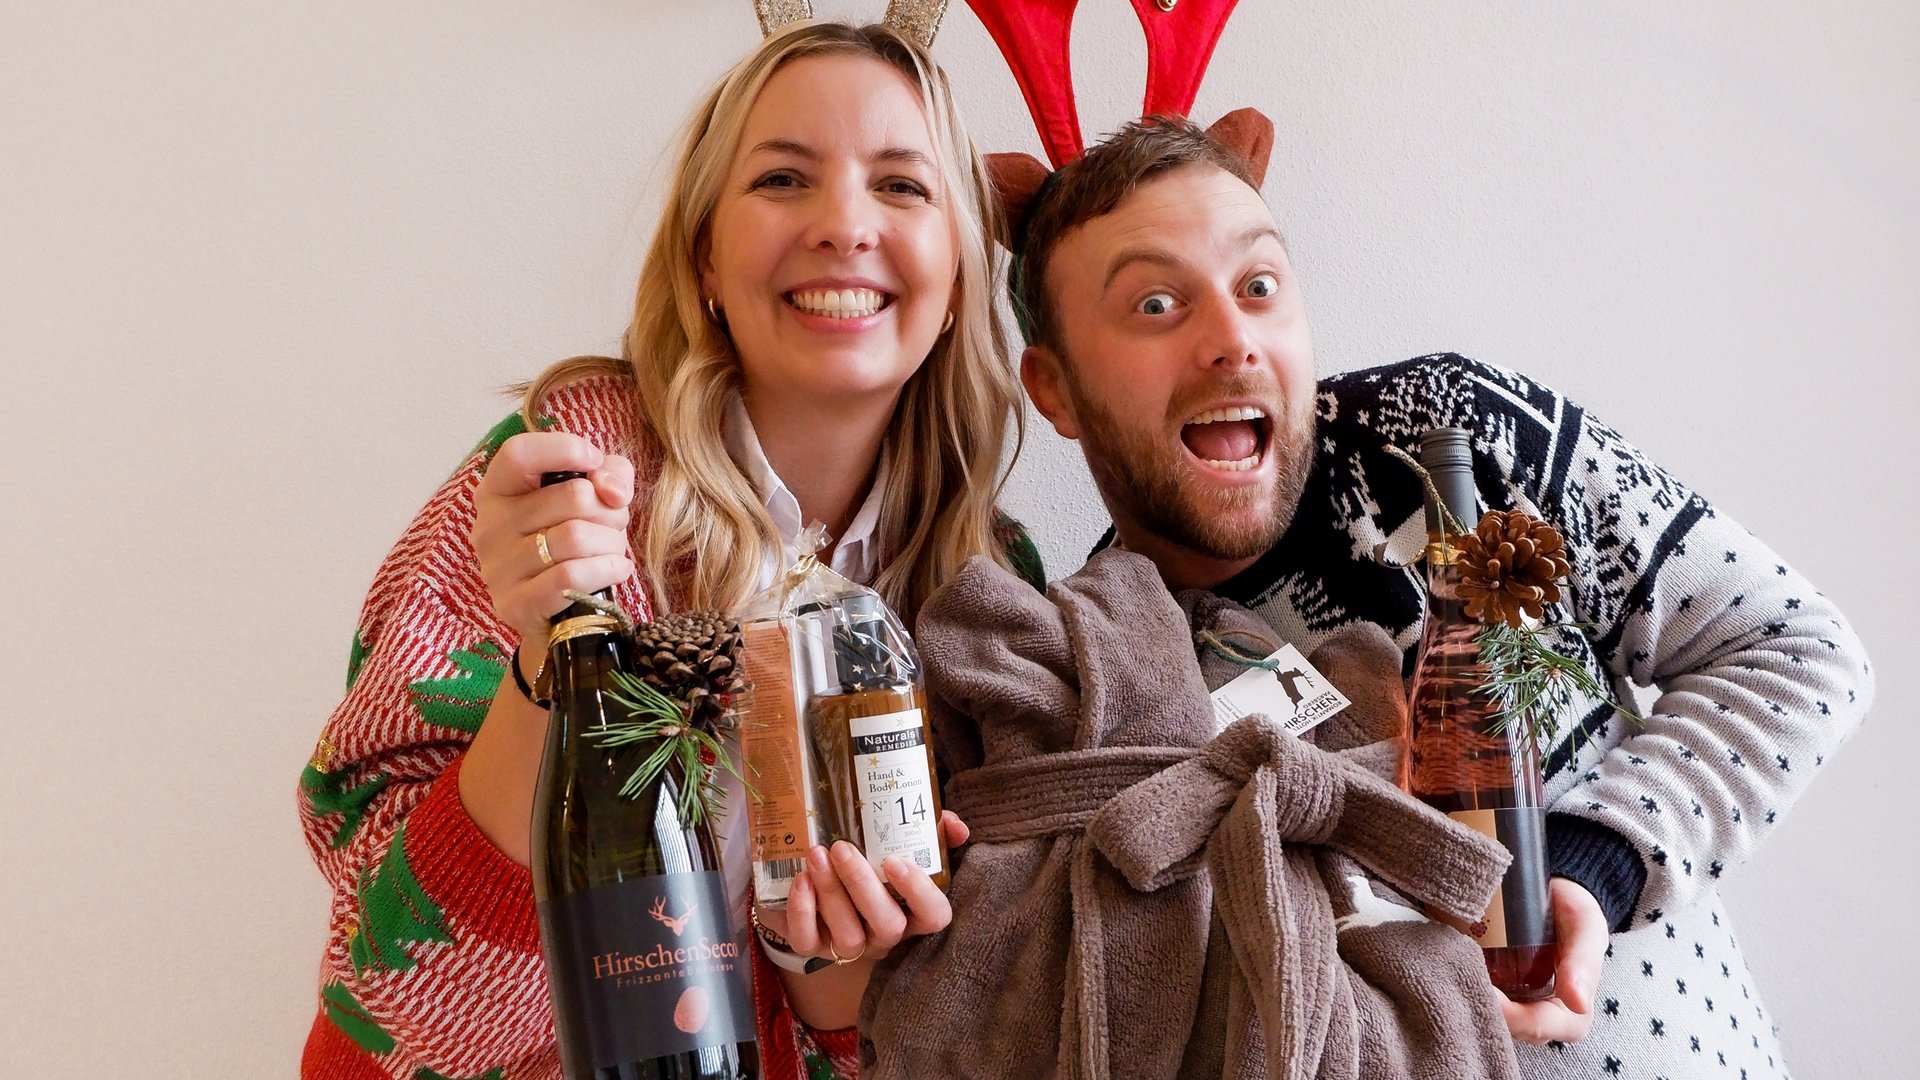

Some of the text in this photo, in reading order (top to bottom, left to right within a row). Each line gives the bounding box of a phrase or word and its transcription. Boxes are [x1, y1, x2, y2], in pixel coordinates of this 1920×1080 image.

[1312, 701, 1342, 721] ROMANTIK
[864, 731, 916, 746] Naturals
[876, 740, 917, 752] REMEDIES
[867, 768, 905, 782] Hand &
[869, 778, 922, 794] Body Lotion
[895, 792, 926, 826] 14
[884, 840, 926, 852] vegan formula
[592, 937, 738, 980] HirschenSecco
